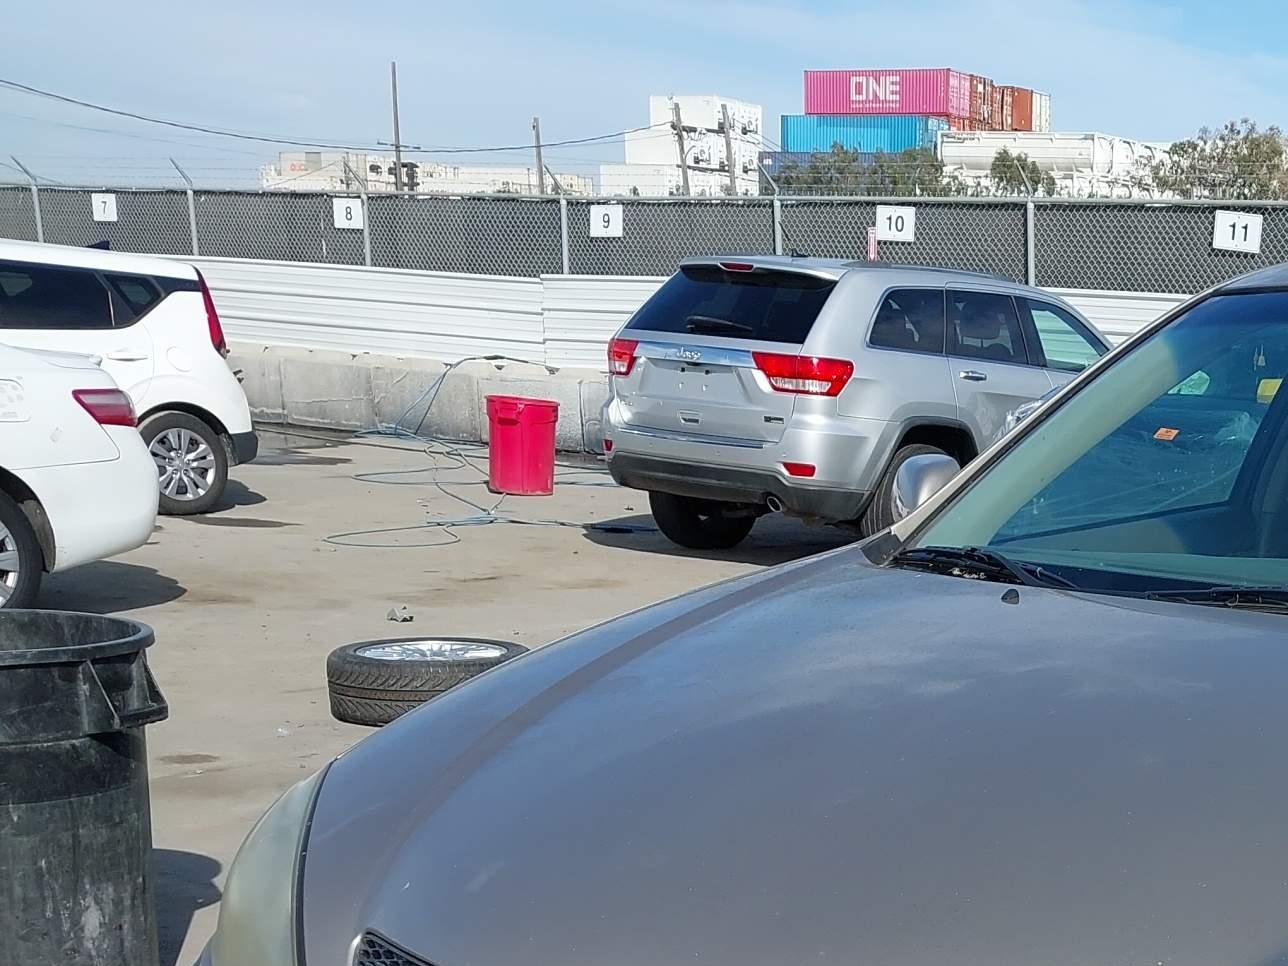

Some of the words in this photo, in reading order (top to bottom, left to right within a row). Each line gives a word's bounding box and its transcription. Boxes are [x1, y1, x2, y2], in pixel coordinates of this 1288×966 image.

[850, 75, 900, 101] ONE
[101, 200, 107, 215] 7
[345, 206, 353, 221] 8
[602, 213, 610, 229] 9
[886, 214, 905, 233] 10
[1229, 221, 1248, 242] 11
